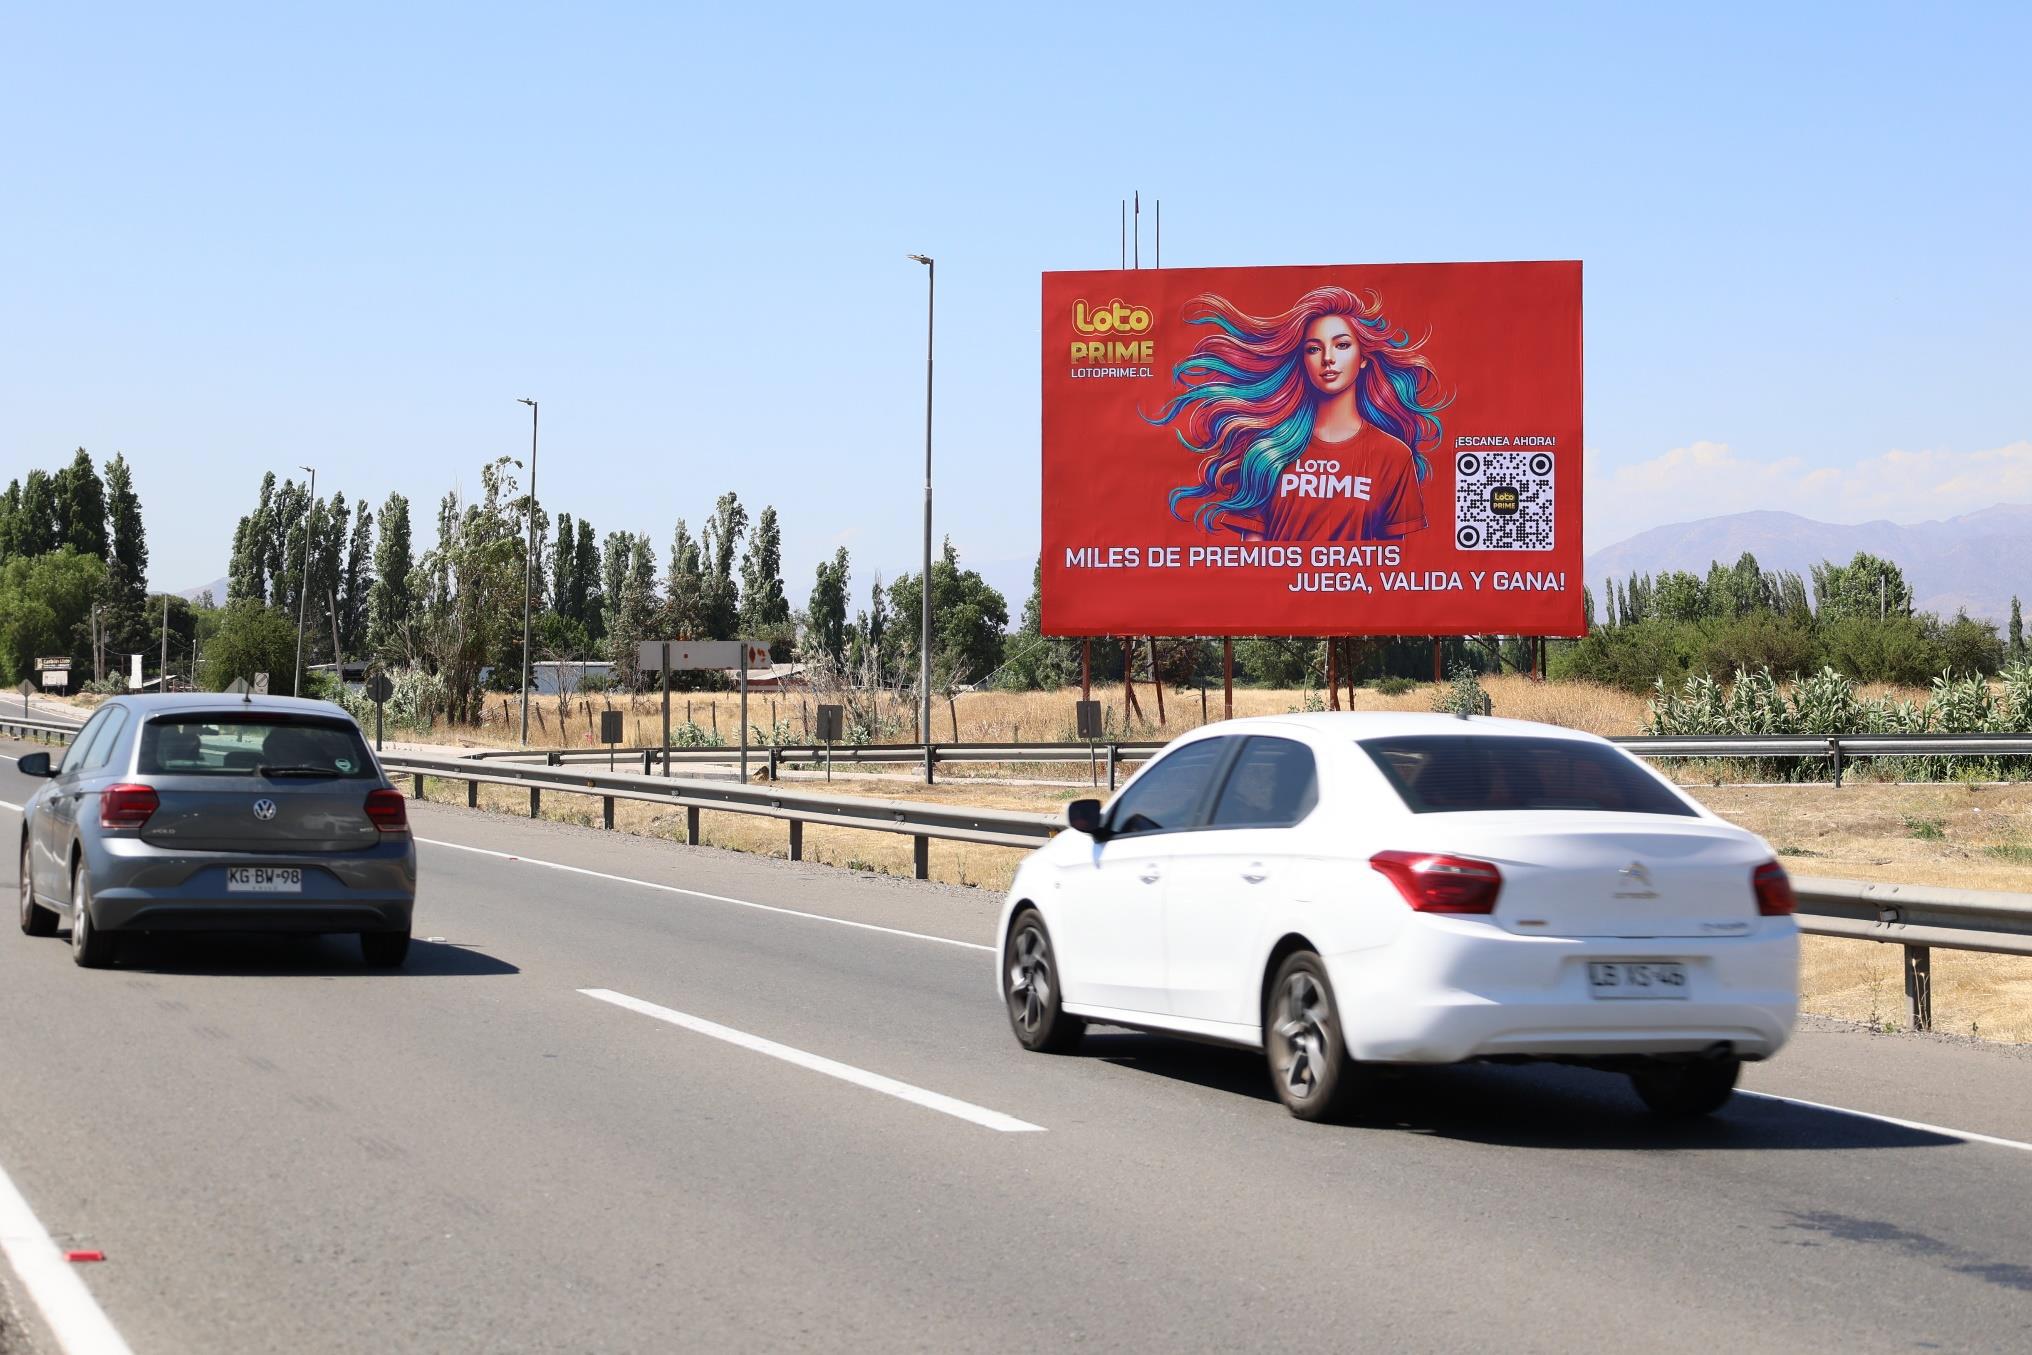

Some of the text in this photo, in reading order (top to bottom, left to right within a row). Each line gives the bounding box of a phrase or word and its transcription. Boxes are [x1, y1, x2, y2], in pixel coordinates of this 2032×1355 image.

[1076, 303, 1150, 332] Loto
[1070, 341, 1154, 364] PRIME
[1071, 367, 1154, 378] LOTOPRIME.CL
[1455, 437, 1555, 448] ¡ESCANEA AHORA!
[1295, 458, 1340, 473] LOTO
[1280, 474, 1372, 501] PRIME
[1493, 502, 1516, 510] PRIME
[1066, 544, 1402, 568] MILES DE PREMIOS GRATIS
[1287, 571, 1566, 593] JUEGA, VALIDA Y GANA!
[229, 868, 250, 885] KG
